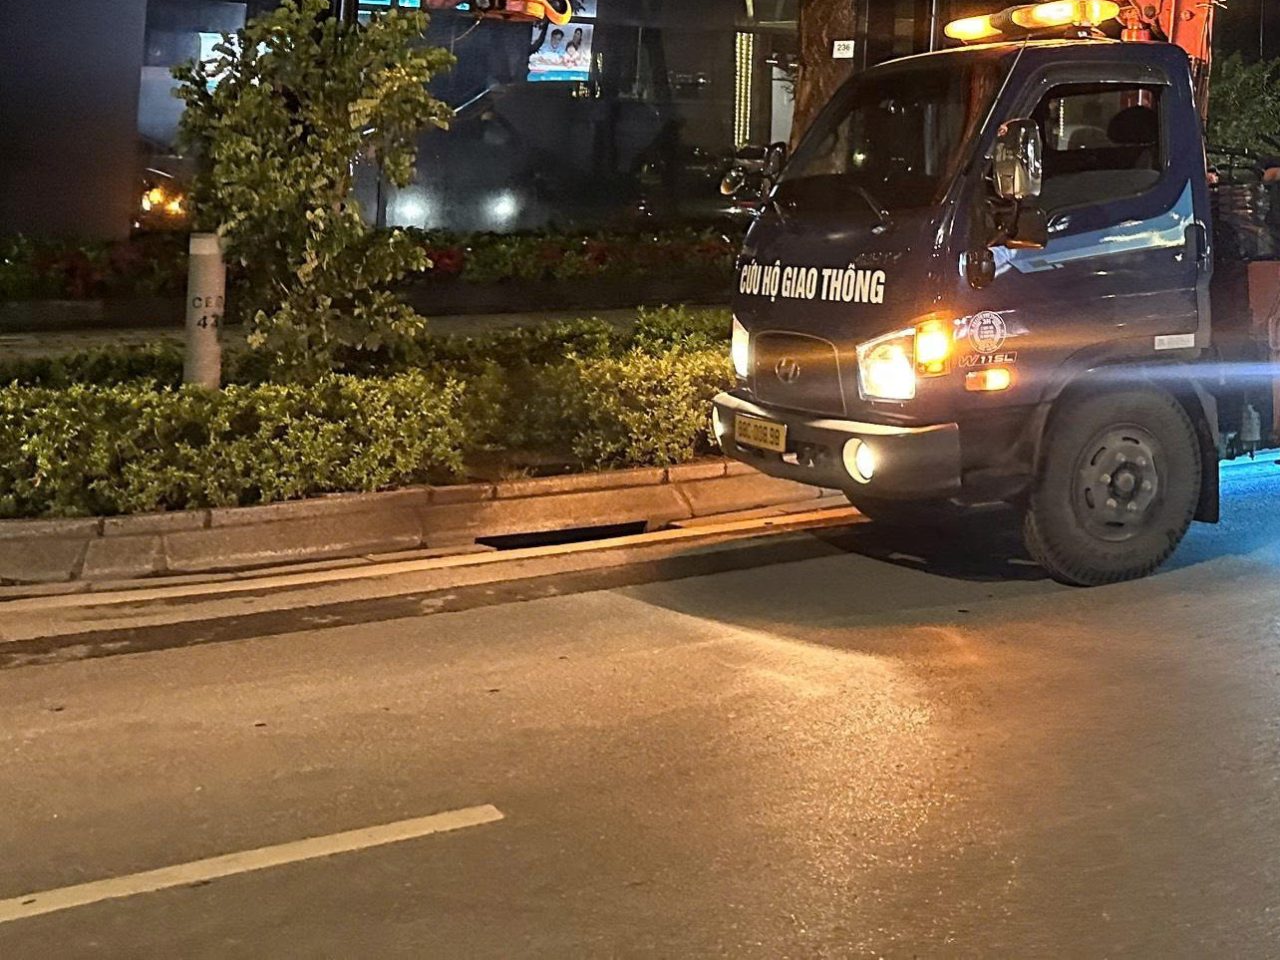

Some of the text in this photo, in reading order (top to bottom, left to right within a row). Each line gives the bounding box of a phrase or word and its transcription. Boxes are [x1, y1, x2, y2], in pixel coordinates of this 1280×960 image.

[762, 259, 781, 302] HỘ
[781, 265, 818, 300] GIAO
[820, 262, 886, 304] THÔNG
